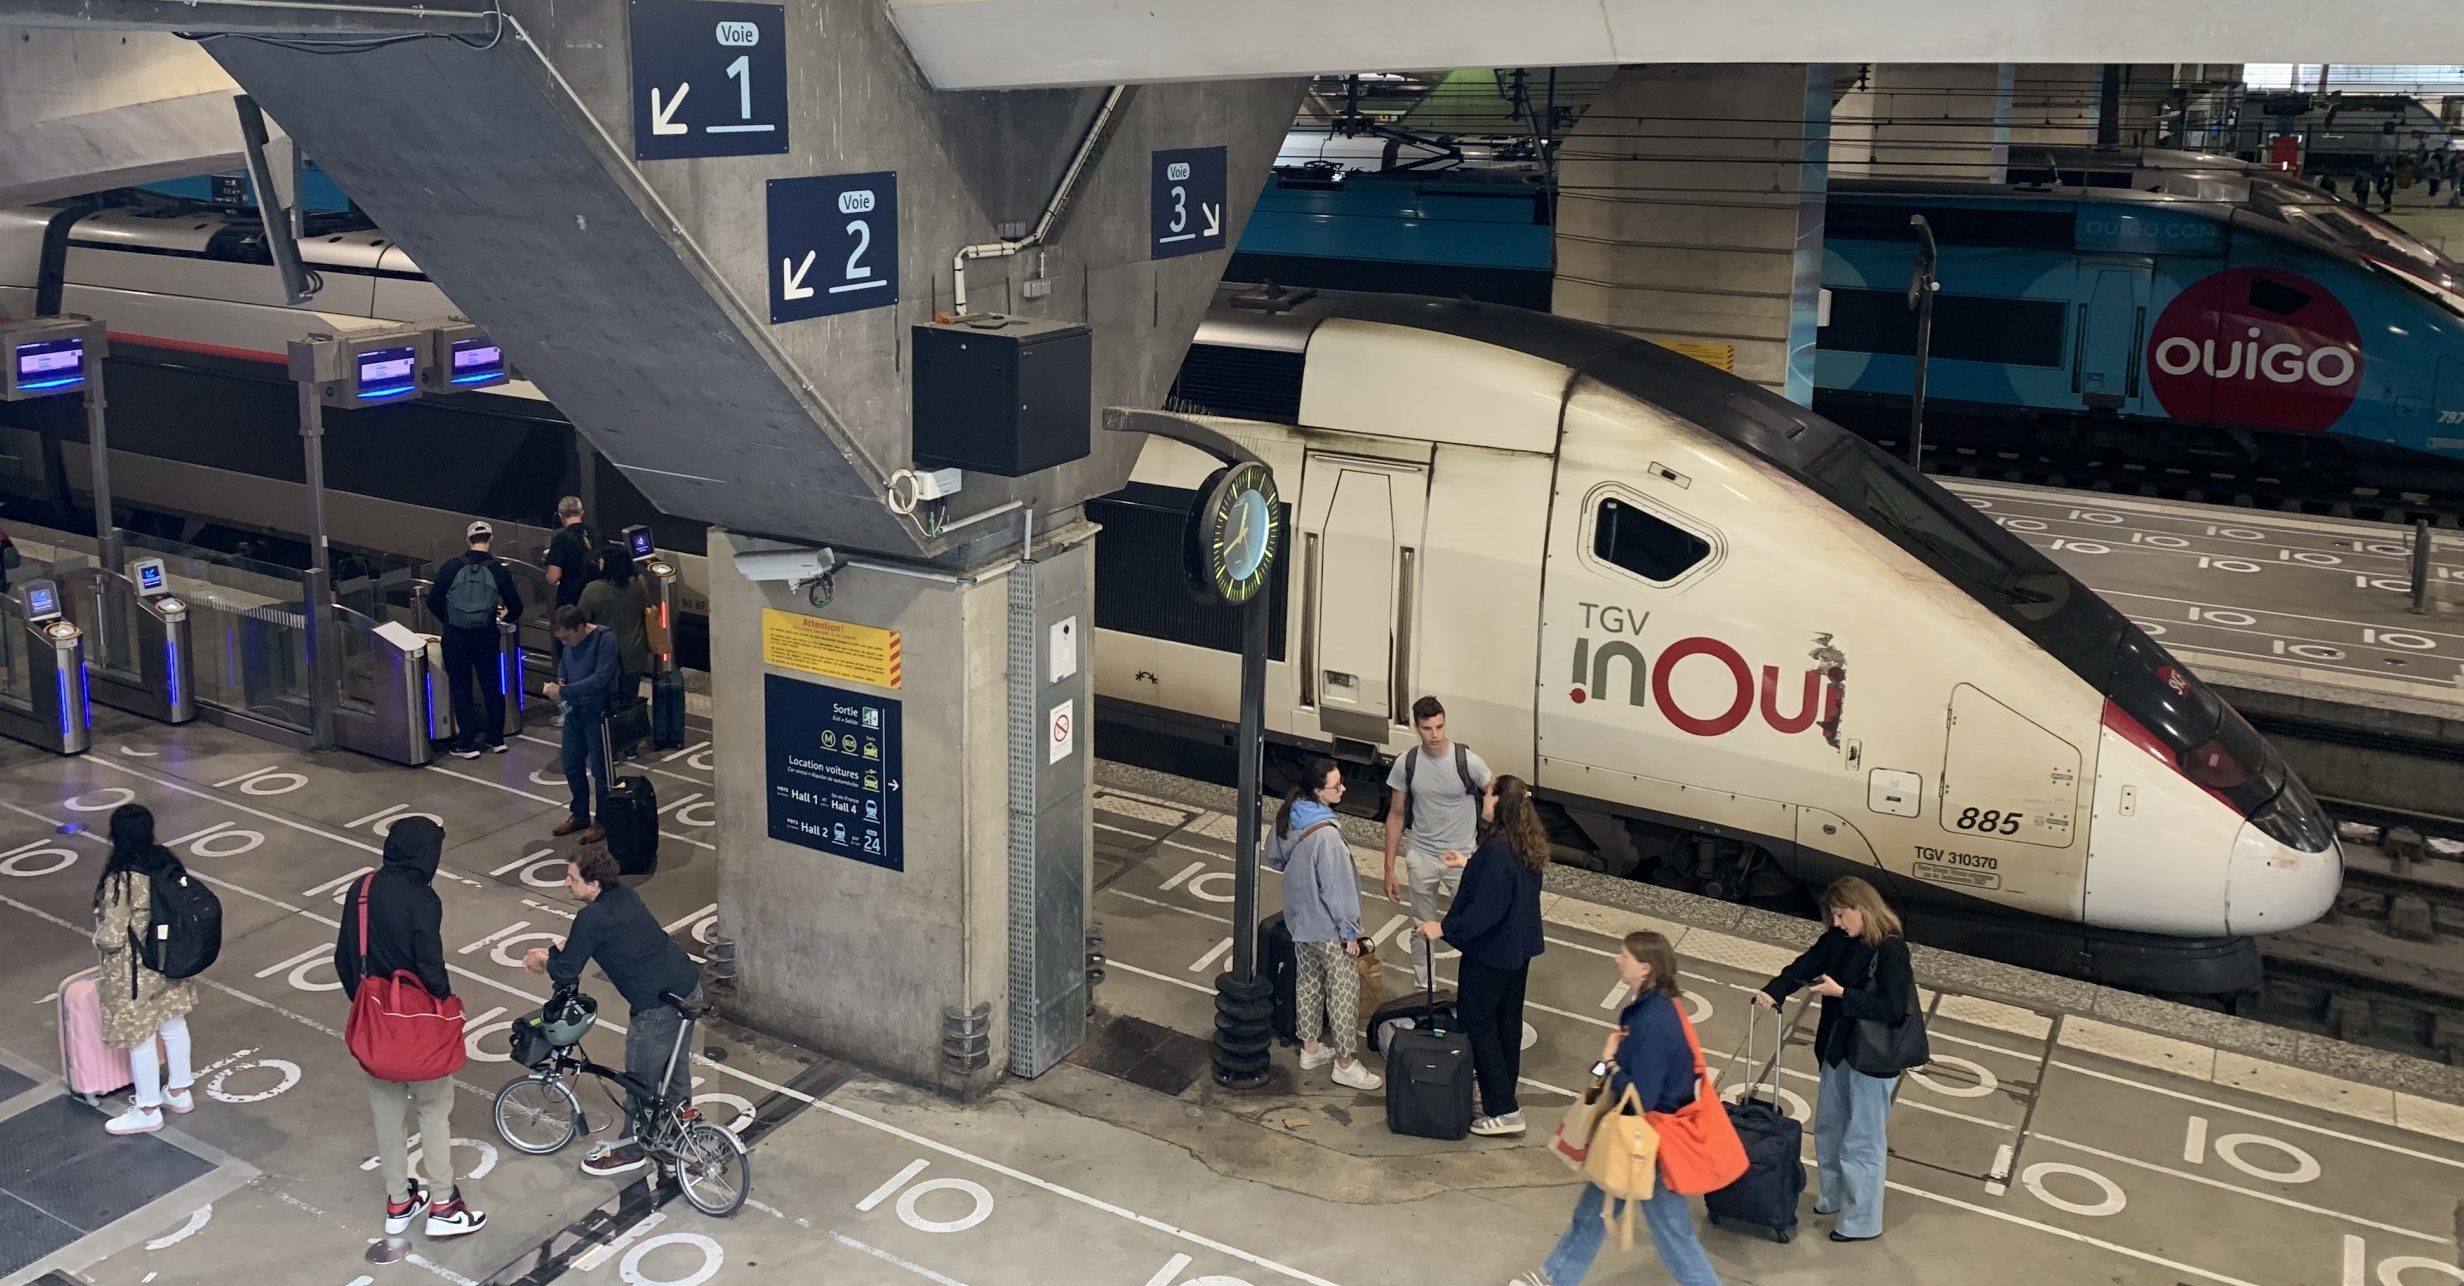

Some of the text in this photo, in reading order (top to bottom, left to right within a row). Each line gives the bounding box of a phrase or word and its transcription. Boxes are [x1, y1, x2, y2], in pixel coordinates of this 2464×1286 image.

[721, 25, 753, 43] Voie
[726, 55, 751, 119] 1
[1169, 165, 1187, 178] Voie
[843, 194, 870, 211] Voie
[1169, 185, 1187, 233] 3
[845, 219, 871, 280] 2
[1578, 602, 1651, 637] TGV
[833, 703, 859, 718] Sortie
[788, 754, 859, 780] Location voitures
[791, 789, 811, 803] Hall
[813, 794, 818, 805] 1
[831, 800, 849, 813] Hall
[850, 804, 857, 815] 4
[801, 821, 820, 836] Hall
[822, 827, 829, 838] 2
[1957, 807, 2024, 836] 885
[863, 835, 880, 852] 24
[1914, 846, 1998, 870] TGV 310370
